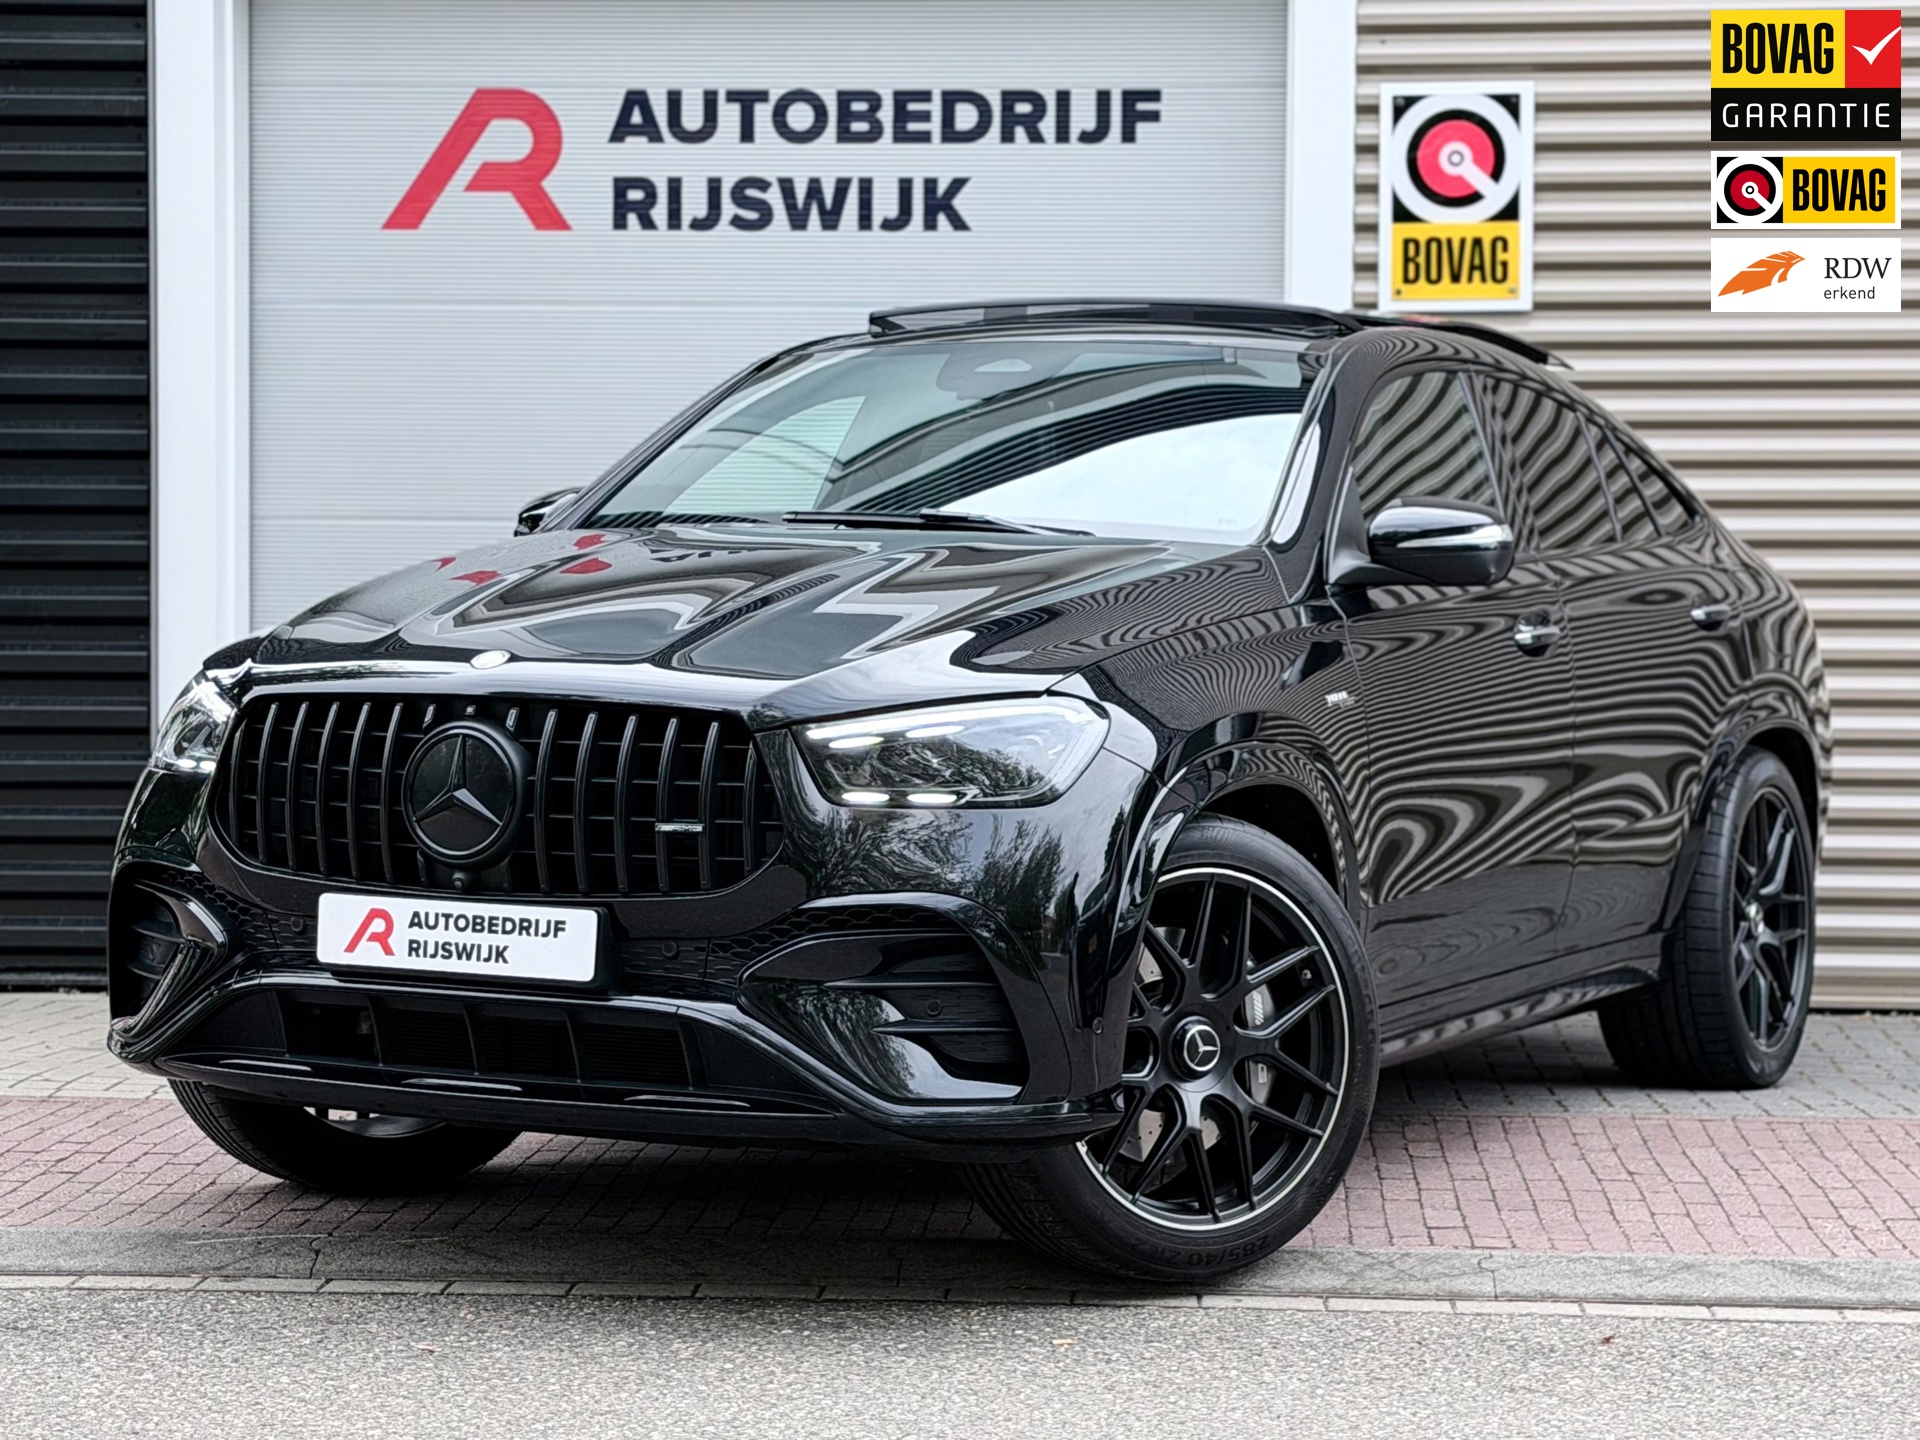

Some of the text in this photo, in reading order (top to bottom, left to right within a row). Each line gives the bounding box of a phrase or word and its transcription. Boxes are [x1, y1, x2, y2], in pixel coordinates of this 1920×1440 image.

[608, 88, 1162, 144] AUTOBEDRIJF
[613, 176, 970, 232] RIJSWIJK
[1403, 236, 1508, 285] BOVAG
[408, 911, 567, 938] AUTOBEDRIJF
[407, 939, 509, 964] RIJSWIJK
[1187, 1235, 1271, 1267] 285/40
